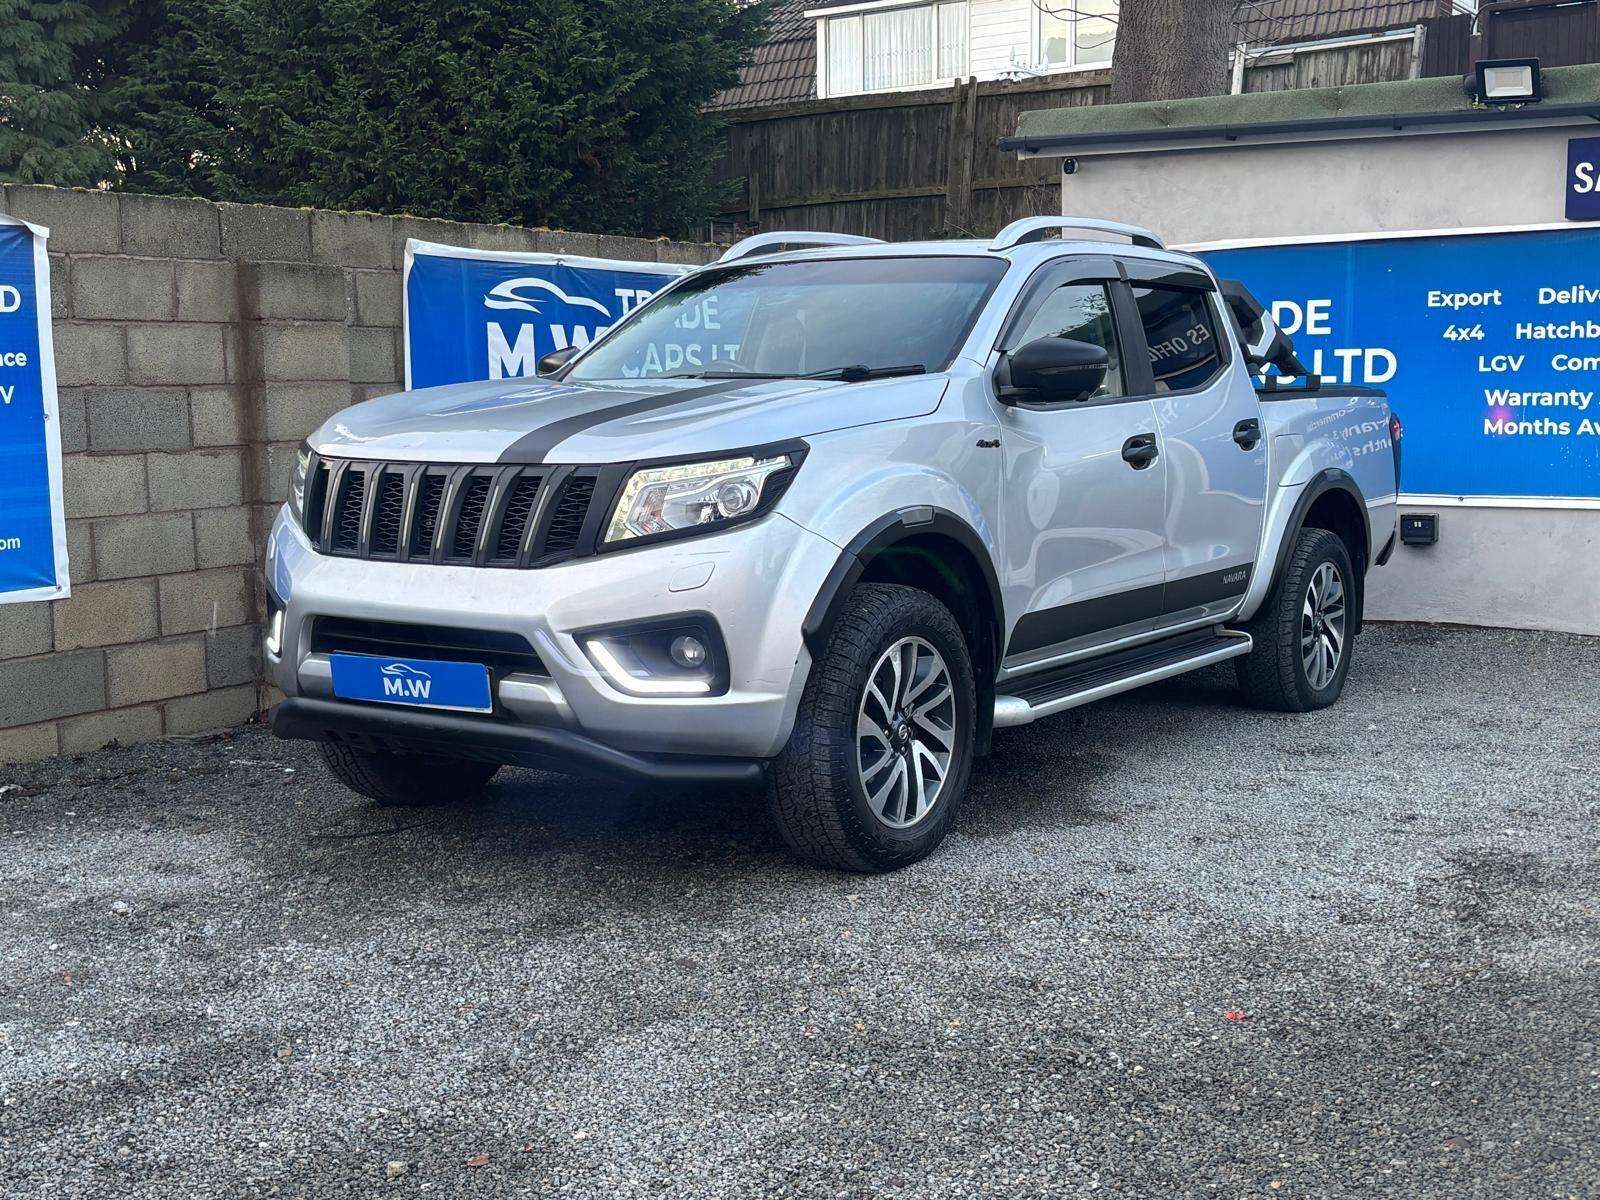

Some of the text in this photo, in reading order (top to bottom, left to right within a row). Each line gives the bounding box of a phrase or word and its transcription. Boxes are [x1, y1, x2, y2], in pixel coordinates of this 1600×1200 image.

[1427, 284, 1600, 311] Export Deliv
[1443, 324, 1485, 341] 4x4
[1312, 348, 1397, 384] LTD
[1479, 354, 1525, 372] LGV
[1484, 389, 1594, 410] Warranty
[1483, 418, 1571, 436] Months
[383, 677, 432, 699] M.W
